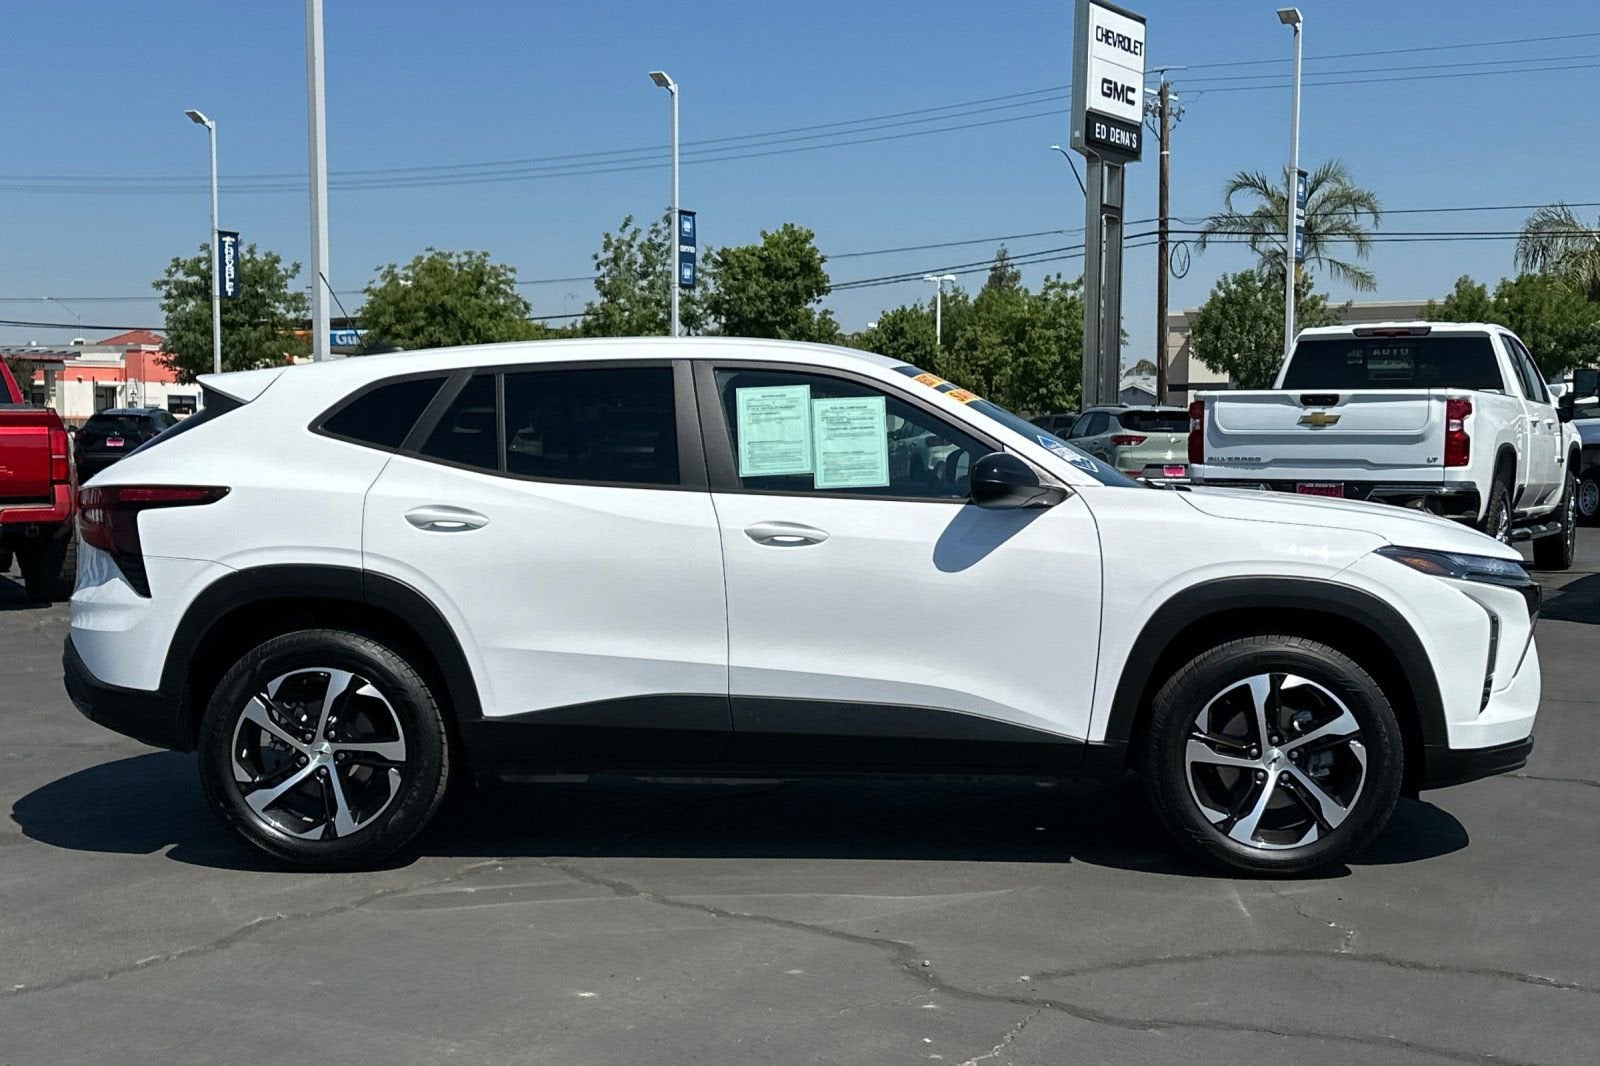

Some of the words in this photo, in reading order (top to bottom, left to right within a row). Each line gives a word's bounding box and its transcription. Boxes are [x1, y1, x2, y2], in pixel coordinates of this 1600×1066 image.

[1095, 25, 1144, 57] CHEVROLET
[1101, 77, 1136, 106] GMC
[1095, 122, 1107, 139] ED
[1109, 126, 1137, 149] DENA'S
